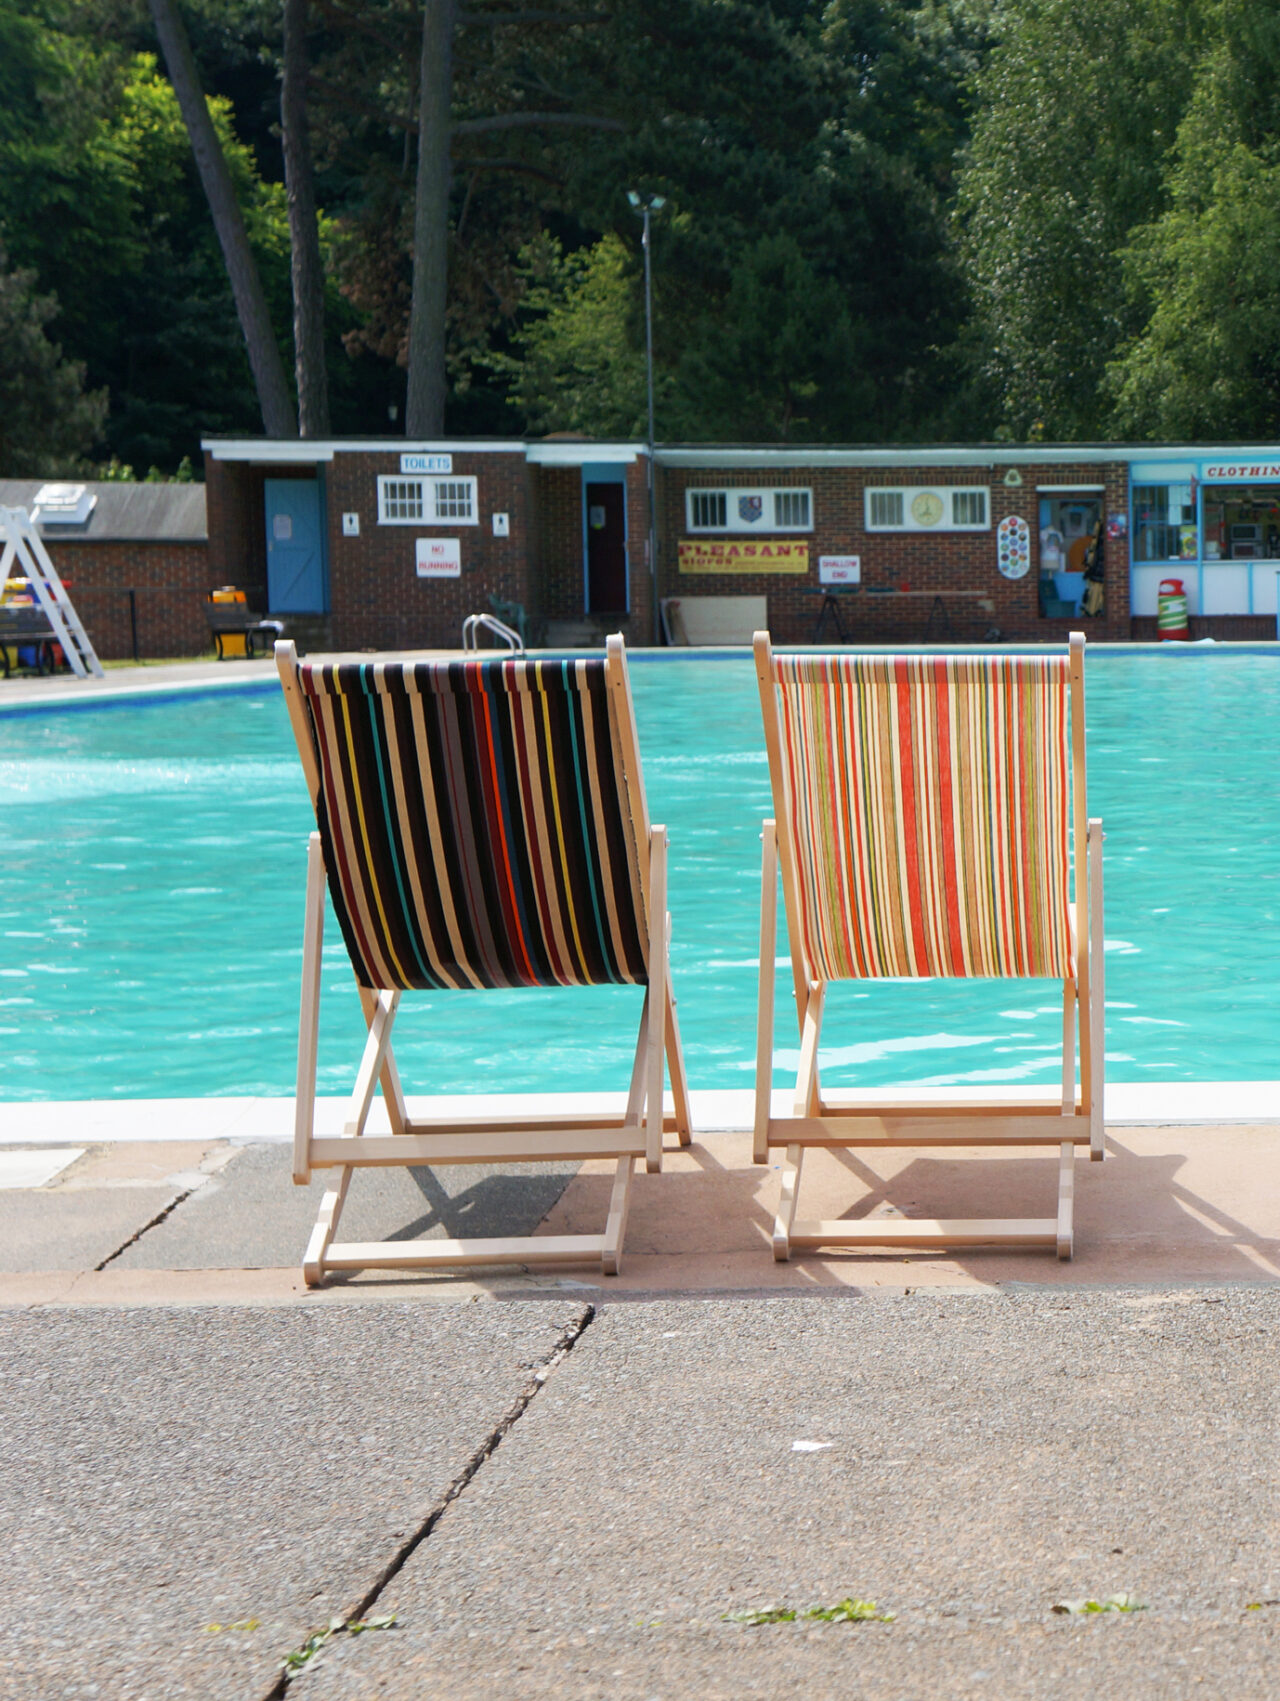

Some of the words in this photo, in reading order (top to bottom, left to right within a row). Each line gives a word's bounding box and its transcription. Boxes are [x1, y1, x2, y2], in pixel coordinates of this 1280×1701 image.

[404, 457, 450, 470] TOILETS
[431, 545, 444, 554] NO
[678, 544, 809, 557] PLEASANT
[823, 560, 857, 568] SHALLOW
